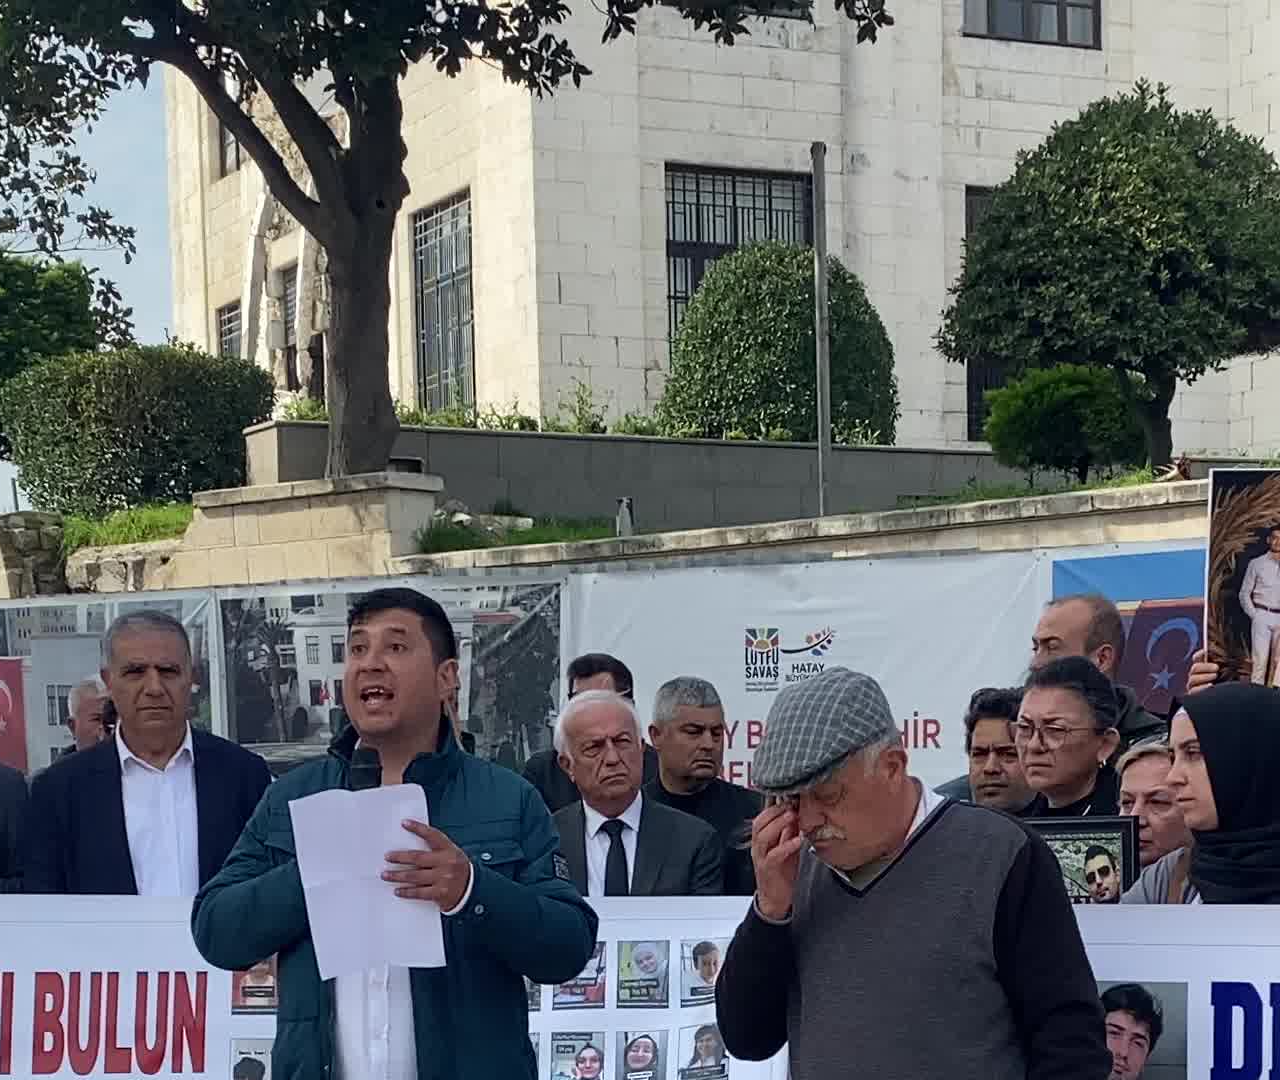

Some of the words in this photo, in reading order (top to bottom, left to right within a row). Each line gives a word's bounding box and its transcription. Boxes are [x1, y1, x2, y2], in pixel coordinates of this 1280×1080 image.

[745, 666, 779, 681] SAVAŞ
[792, 663, 825, 674] HATAY
[31, 970, 208, 1075] BULUN
